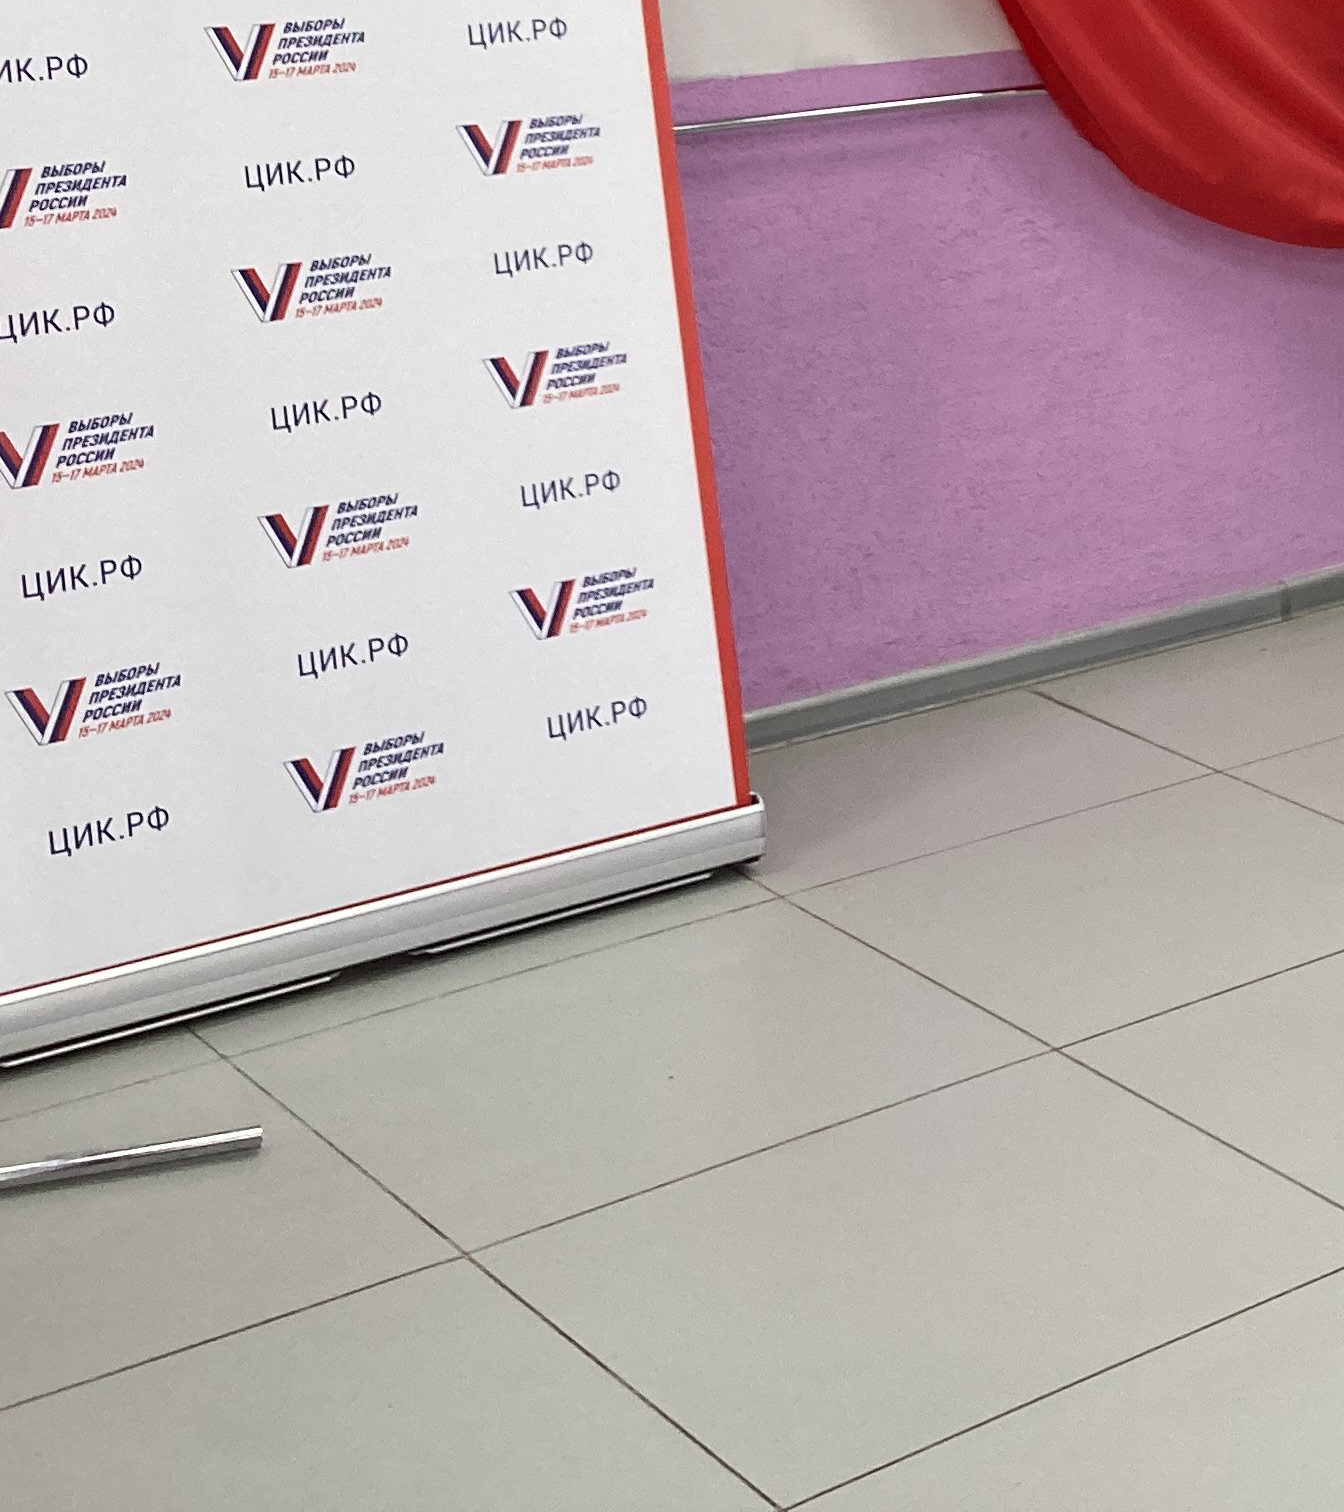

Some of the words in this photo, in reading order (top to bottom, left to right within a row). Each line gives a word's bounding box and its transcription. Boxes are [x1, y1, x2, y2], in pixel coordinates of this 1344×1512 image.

[283, 18, 345, 34] ВЫБОРЫ
[467, 17, 567, 50] ЦИК.РФ
[278, 32, 364, 50] ПРЕЗИДЕНТА
[0, 53, 88, 83] ИК.РФ
[273, 50, 329, 66] РОССИИ
[41, 161, 106, 178] ВЫБОРЫ
[245, 154, 355, 192] ЦИК.РФ
[35, 175, 126, 195] ПРЕЗИДЕНТА
[29, 195, 88, 212] РОССИИ
[310, 254, 371, 272] ВЫБОРЫ
[493, 241, 593, 277] ЦИК.РФ
[304, 267, 391, 288] ПРЕЗИДЕНТА
[299, 287, 355, 304] РОССИИ
[0, 302, 115, 344] ЦИК.РФ
[68, 412, 133, 433] ВЫБОРЫ
[271, 391, 381, 433] ЦИК.РФ
[62, 425, 154, 451] ПРЕЗИДЕНТА
[56, 447, 115, 468] РОССИИ
[521, 469, 620, 510] ЦИК.РФ
[337, 493, 398, 514] ВЫБОРЫ
[331, 505, 418, 531] ПРЕЗИДЕНТА
[326, 527, 382, 547] РОССИИ
[21, 554, 142, 601] ЦИК.РФ
[298, 632, 408, 679] ЦИК.РФ
[95, 662, 160, 687] ВЫБОРЫ
[89, 675, 181, 705] ПРЕЗИДЕНТА
[82, 698, 142, 723] РОССИИ
[547, 696, 647, 741] ЦИК.РФ
[363, 731, 425, 755] ВЫБОРЫ
[358, 743, 444, 773] ПРЕЗИДЕНТА
[352, 767, 408, 790] РОССИИ
[48, 805, 169, 858] ЦИК.РФ
